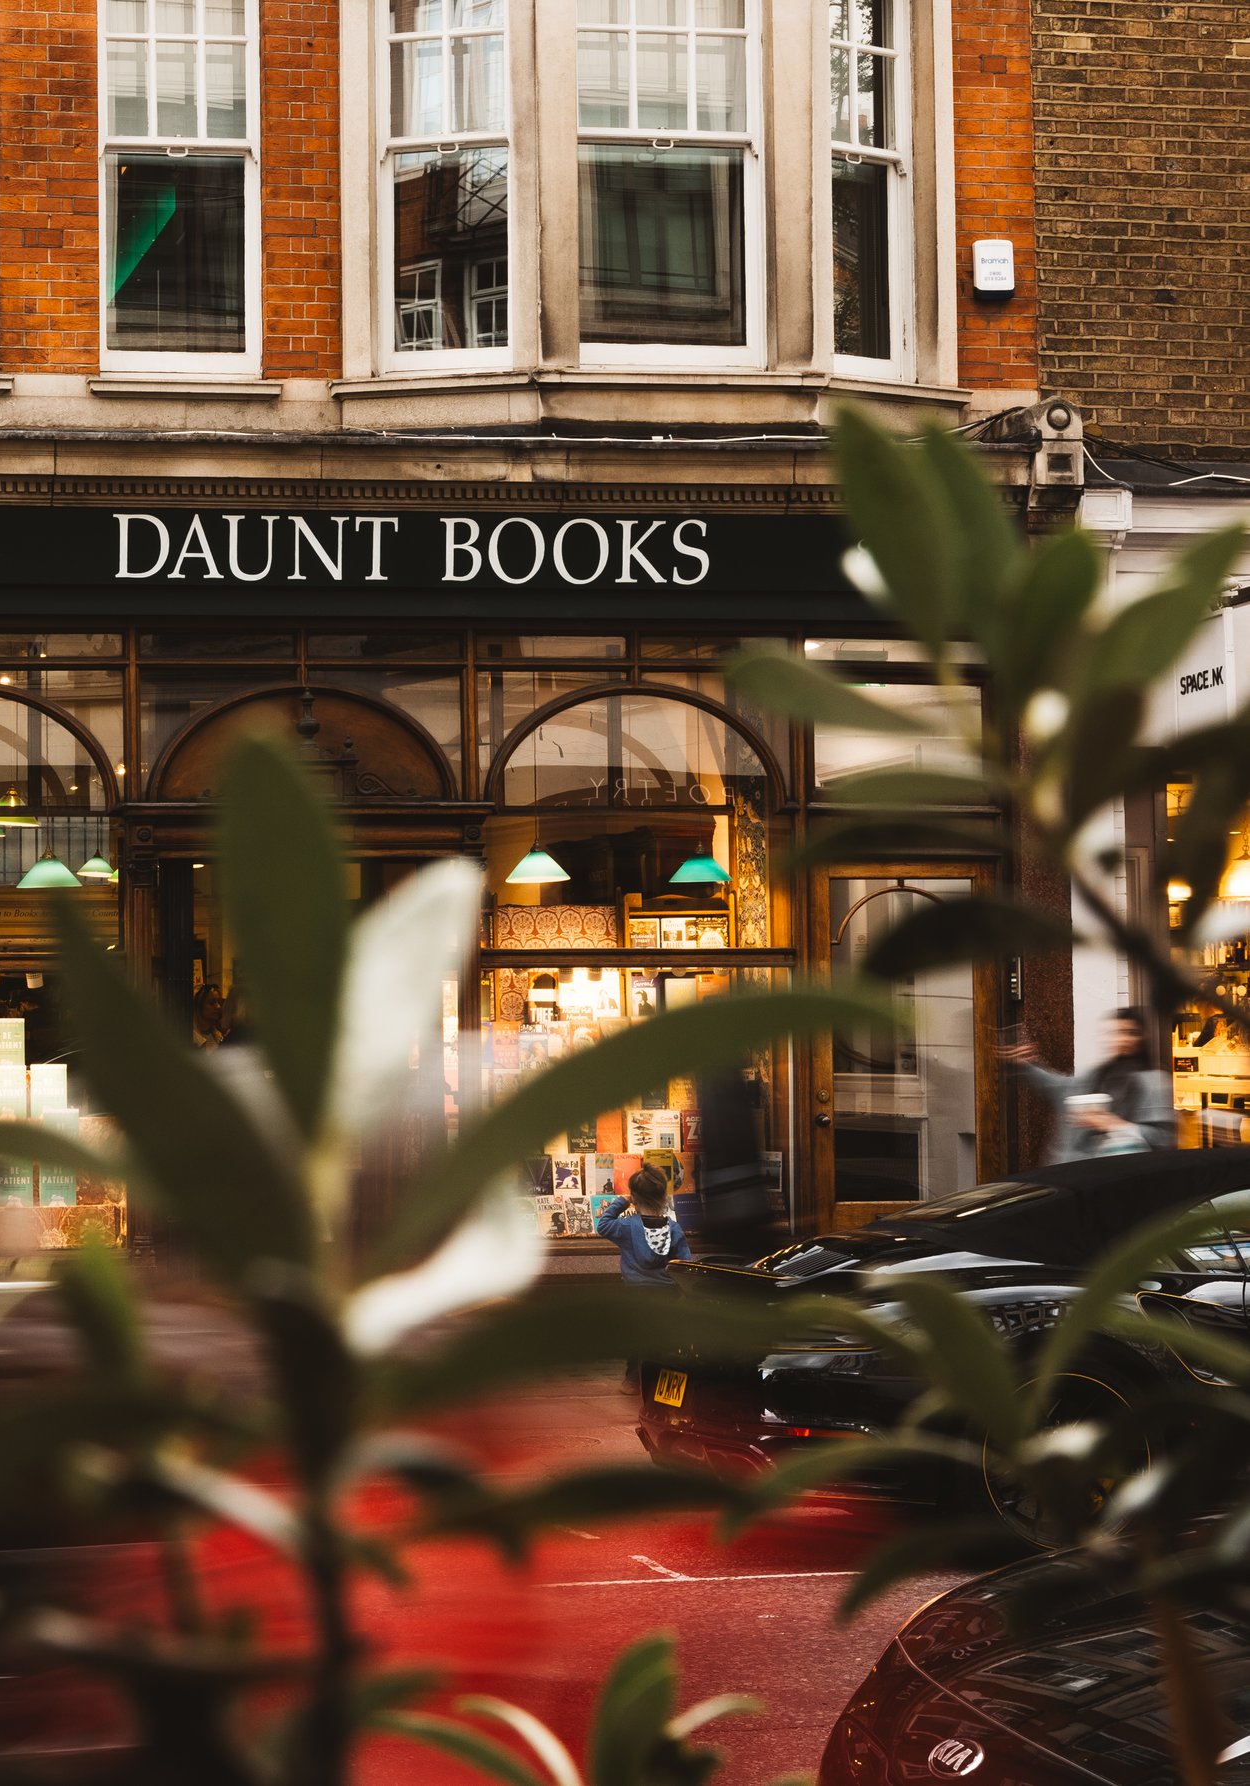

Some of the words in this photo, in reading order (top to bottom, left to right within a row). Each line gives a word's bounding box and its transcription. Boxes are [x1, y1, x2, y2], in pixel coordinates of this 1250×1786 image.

[113, 513, 399, 581] DAUNT
[440, 517, 710, 585] BOOKS
[1180, 665, 1224, 695] SPACE.NK
[3, 909, 12, 918] to
[92, 909, 119, 918] Countr
[2, 1032, 12, 1040] BE
[554, 1160, 570, 1168] Whale
[570, 1160, 579, 1168] Fall
[41, 1175, 74, 1184] PATIENT
[934, 1739, 973, 1771] KIA
